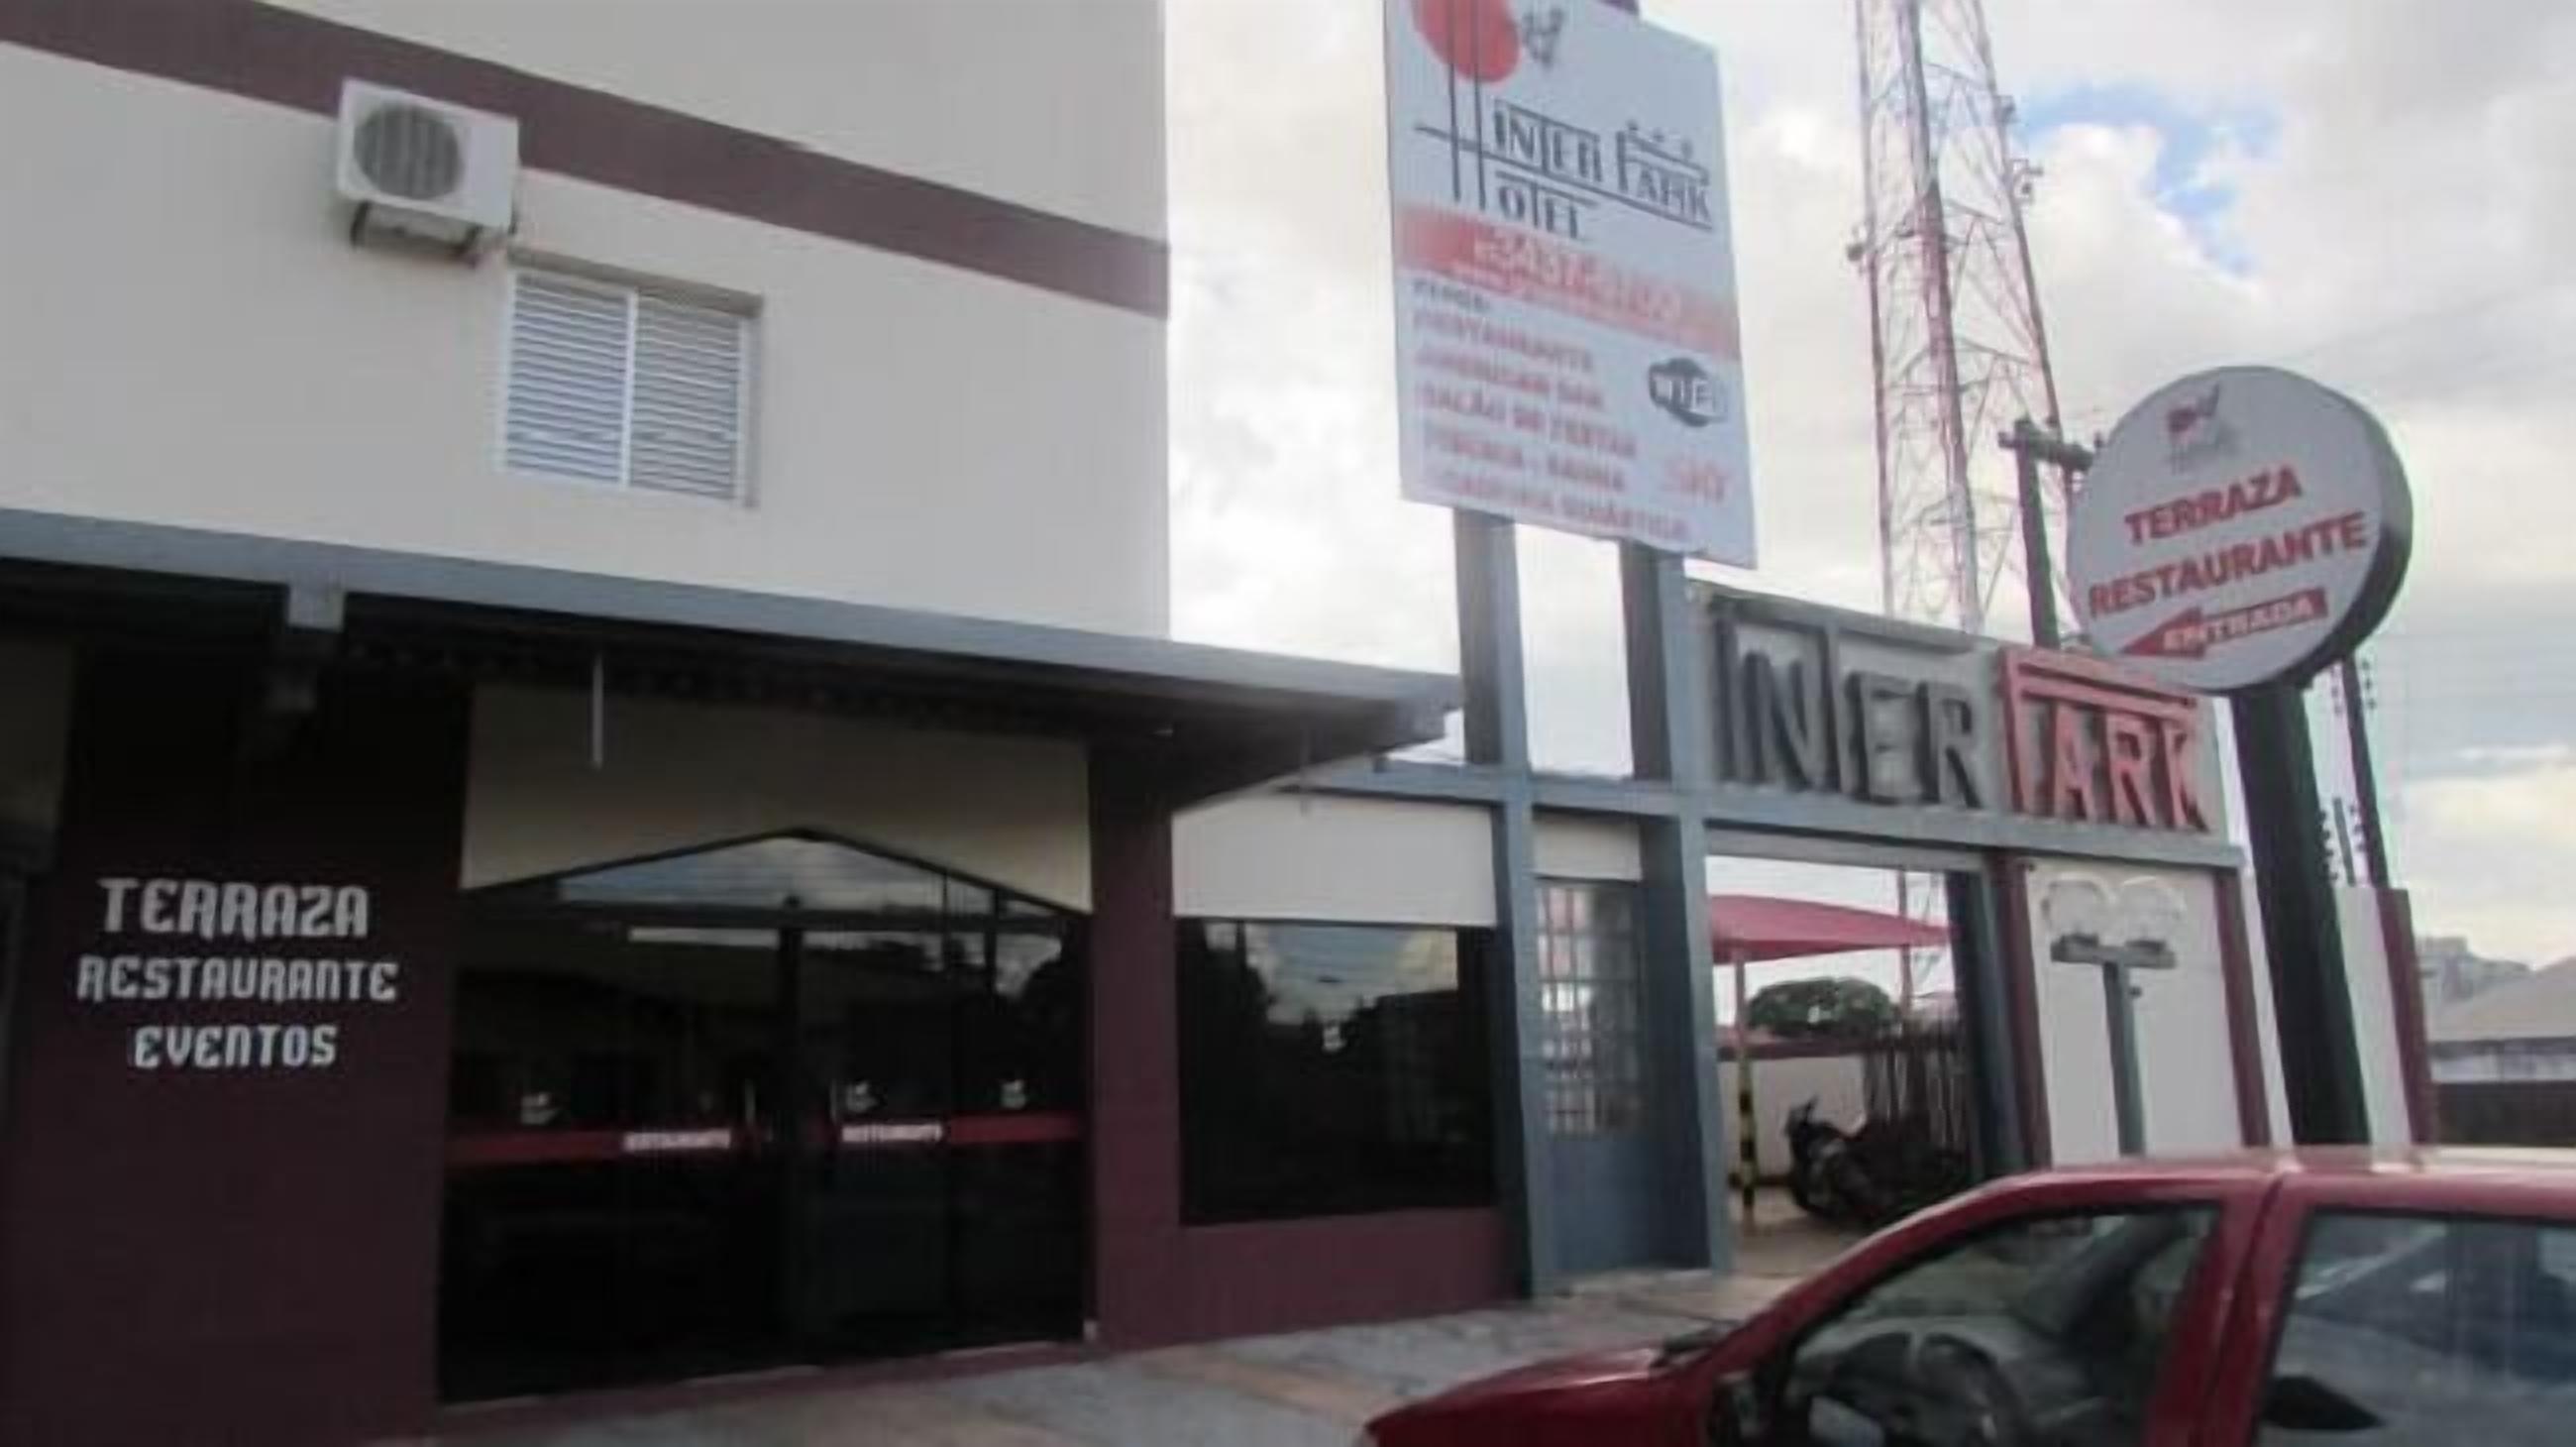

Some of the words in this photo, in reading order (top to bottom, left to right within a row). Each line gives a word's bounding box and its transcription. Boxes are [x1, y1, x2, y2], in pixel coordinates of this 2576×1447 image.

[2124, 464, 2304, 545] TERRAZA
[2088, 509, 2370, 618] RESTAURANTE
[1704, 595, 1985, 809] INTER
[1995, 644, 2211, 835] PARK
[97, 876, 370, 943] TERRAZA
[76, 952, 398, 1004] RESTAURANTE
[133, 1022, 339, 1069] EVENTOS
